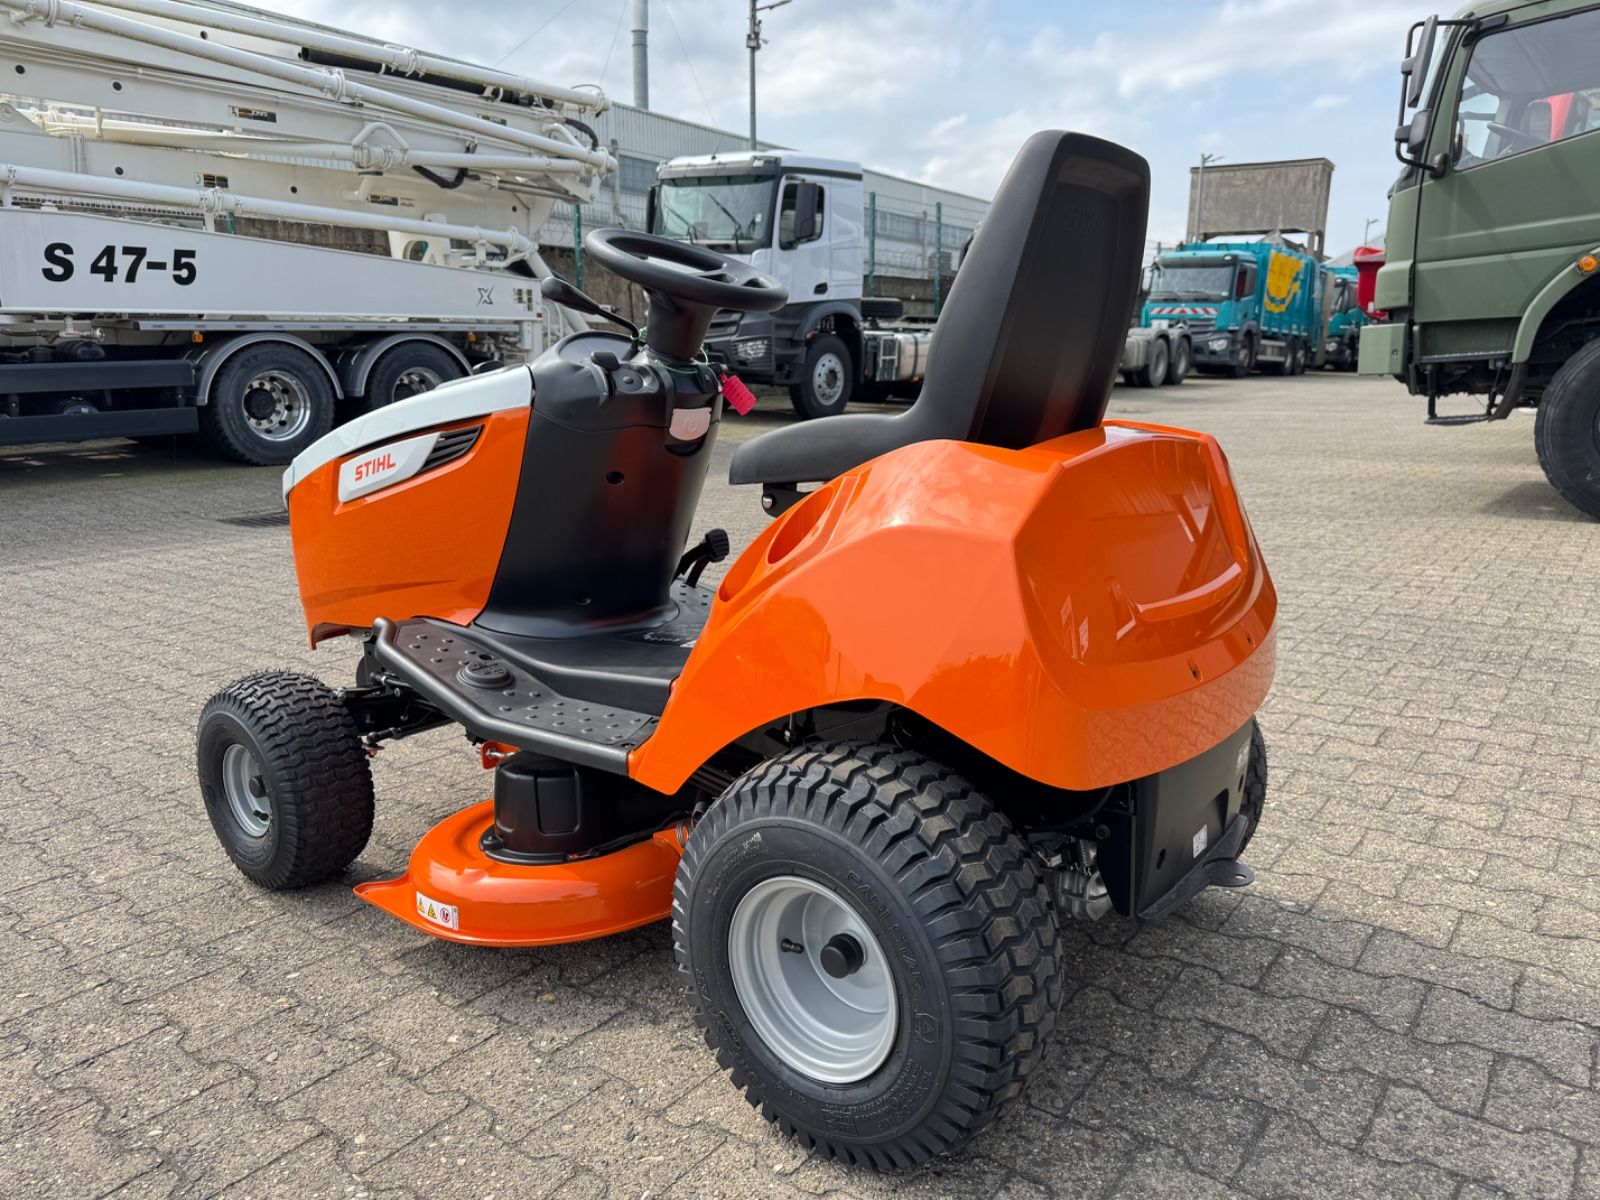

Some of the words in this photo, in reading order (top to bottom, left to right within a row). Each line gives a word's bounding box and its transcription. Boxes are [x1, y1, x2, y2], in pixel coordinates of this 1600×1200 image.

[41, 242, 75, 283] S
[90, 244, 197, 286] 47-5
[354, 453, 396, 482] STIHL
